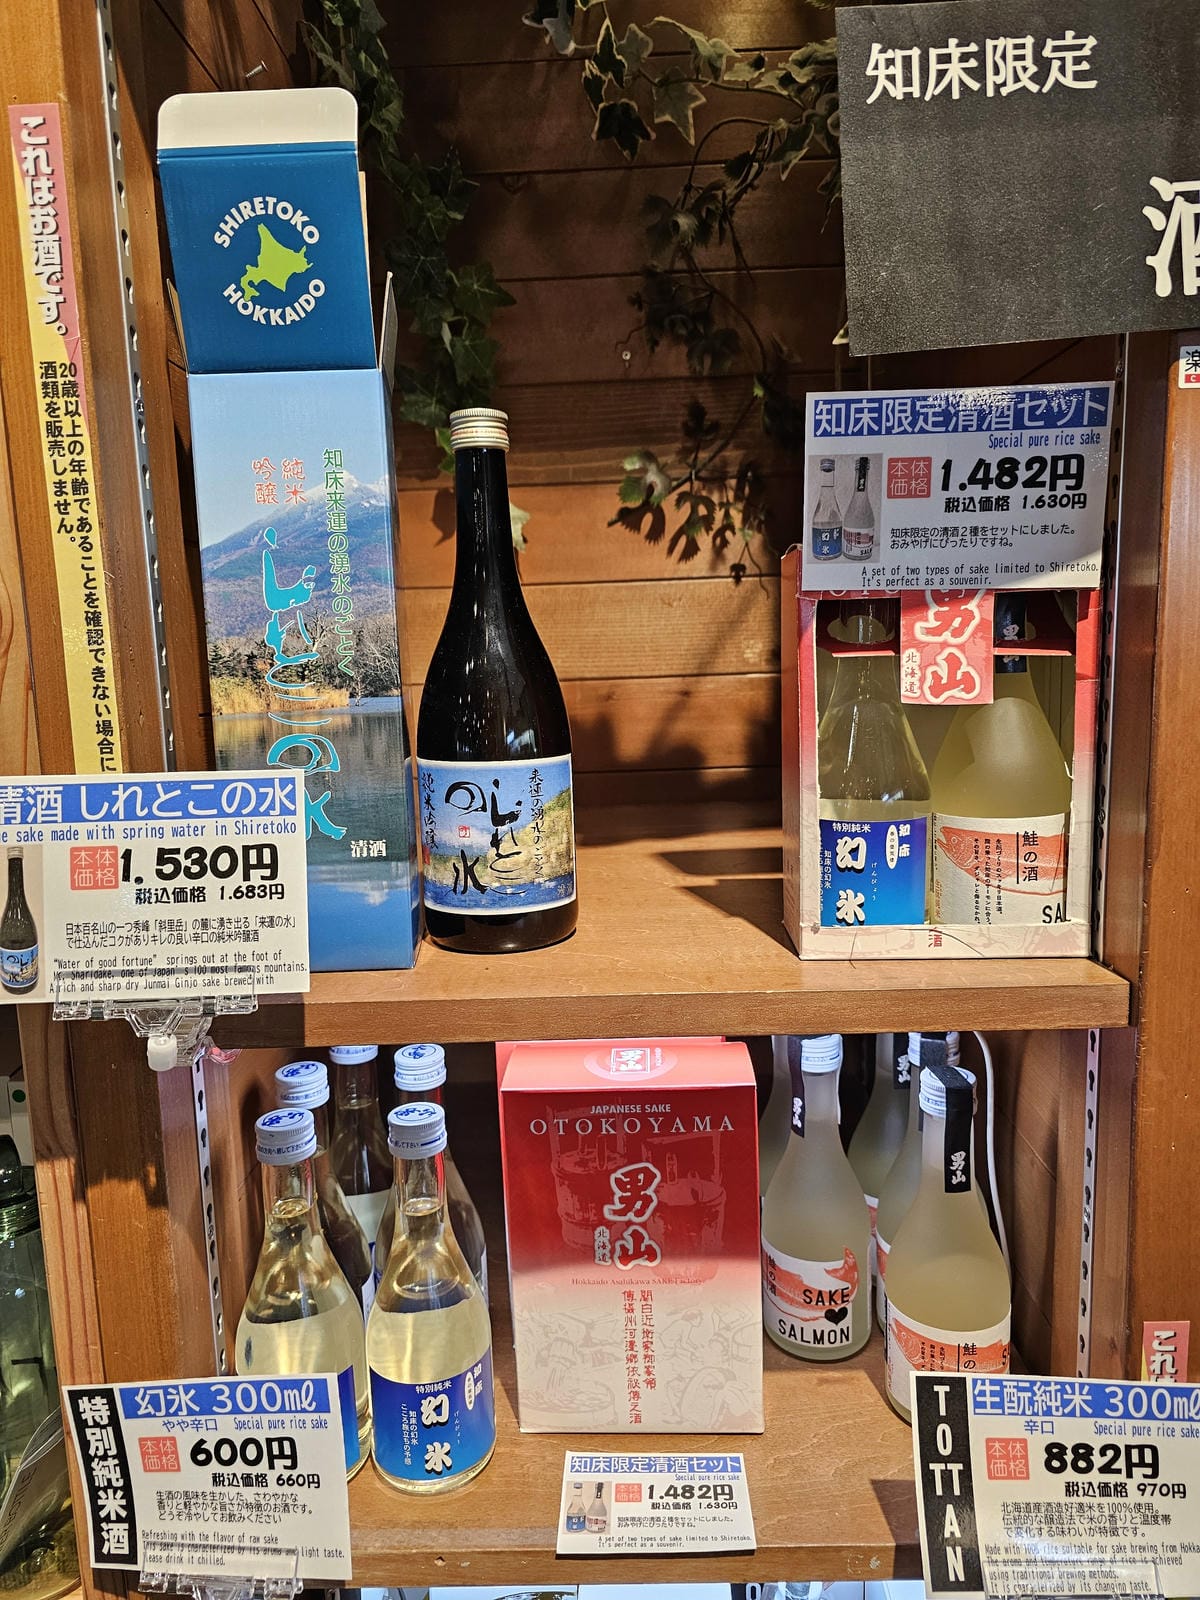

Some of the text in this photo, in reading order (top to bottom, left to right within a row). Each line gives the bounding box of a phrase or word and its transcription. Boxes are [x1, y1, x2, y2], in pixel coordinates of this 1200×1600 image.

[864, 30, 1099, 105] 知床限定
[19, 115, 68, 337] これはお酒です。
[214, 196, 320, 248] SHIRETOKO
[222, 278, 326, 326] HOKKAIDO
[815, 389, 1107, 436] 知床限定清酒セット
[988, 429, 1101, 450] Special pure rice sake
[39, 361, 76, 543] 酒類を販売しません。
[890, 459, 929, 477] 本体
[940, 453, 1085, 492] 1.482円
[281, 458, 307, 504] 純米
[890, 478, 929, 497] 価格
[943, 492, 1088, 513] 税込価格 1.630円
[323, 448, 355, 677] 知床来運の湧水のごとく
[871, 561, 1099, 578] set of two types of sake limited to Shiretoko.
[861, 574, 992, 588] It's perfect as a souvenir.
[903, 651, 920, 695] 北海道
[80, 778, 296, 821] しれとこの水
[16, 818, 297, 843] sake made with spring water in Shiretoko
[73, 848, 116, 868] 本体
[350, 839, 388, 858] 清酒
[1022, 830, 1039, 882] 鮭の酒
[73, 868, 116, 887] 価格
[134, 883, 286, 905] 税込価格 1.683円
[85, 956, 94, 969] of
[98, 956, 117, 969] good
[166, 953, 198, 967] springs
[202, 953, 216, 964] out
[219, 952, 229, 963] at
[233, 951, 247, 963] the
[251, 950, 269, 962] foot
[273, 949, 283, 962] of
[264, 960, 308, 973] mountains.
[58, 974, 275, 993] rich and sharp dry Junmai Ginjo sake brewed with
[590, 1103, 672, 1114] JAPANESE SAKE
[529, 1115, 735, 1135] OTOKOYAMA
[950, 1150, 967, 1185] 男山
[603, 1162, 662, 1270] 男山
[802, 1286, 850, 1306] SAKE
[778, 1318, 850, 1345] SALMON
[1150, 1330, 1178, 1382] これ
[134, 1384, 200, 1417] 幻氷
[974, 1378, 1093, 1418] 生酛純米
[162, 1417, 218, 1432] やや辛口
[233, 1416, 328, 1431] Special pure rice sake
[1024, 1419, 1055, 1435] 辛口
[1094, 1420, 1200, 1439] Special pure rice sake
[141, 1439, 176, 1454] 本体
[189, 1436, 298, 1471] 600円
[988, 1440, 1026, 1458] 本体
[144, 1454, 178, 1470] 価格
[571, 1456, 741, 1473] 知床限定清酒セット
[990, 1459, 1027, 1477] 価格
[1044, 1441, 1160, 1480] 882円
[77, 1395, 129, 1556] 特別純米酒
[211, 1472, 321, 1489] 税込価格 660円
[647, 1483, 734, 1501] 1.482円
[1064, 1481, 1187, 1499] 税込価格 970円
[158, 1511, 282, 1524] どうぞ冷やしてお飲みください
[141, 1529, 279, 1545] Refreshing with the flavor of raw sake
[165, 1553, 184, 1564] drink
[301, 1546, 320, 1559] light
[323, 1548, 345, 1559] taste.
[1096, 1541, 1177, 1556] for sake brewing from
[1012, 1567, 1119, 1580] traditional methods.
